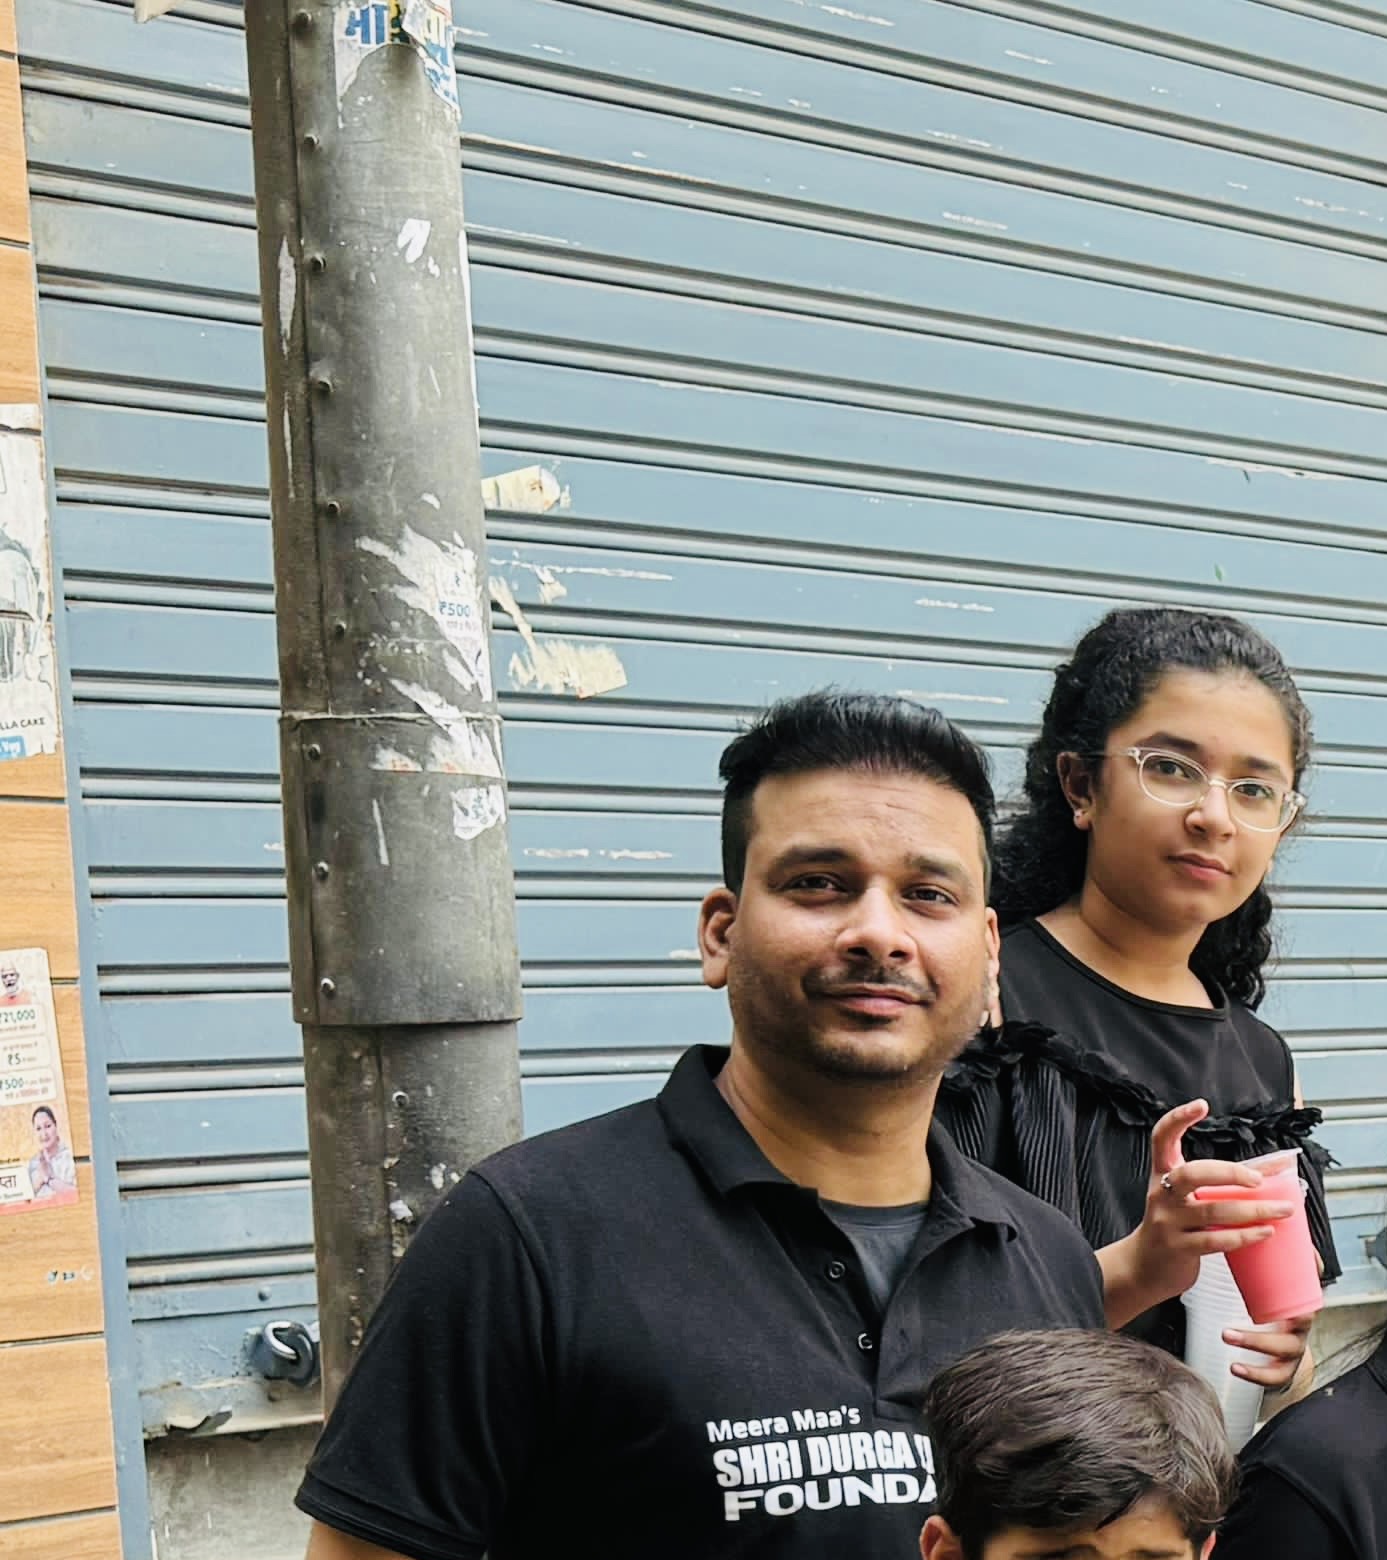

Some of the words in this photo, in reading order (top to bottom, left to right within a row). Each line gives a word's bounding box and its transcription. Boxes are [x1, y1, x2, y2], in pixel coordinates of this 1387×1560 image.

[706, 1416, 790, 1443] Meera
[791, 1405, 862, 1432] Maa's
[713, 1440, 804, 1488] SHRI
[806, 1430, 918, 1476] DURGA
[724, 1473, 938, 1522] FOUNDA
